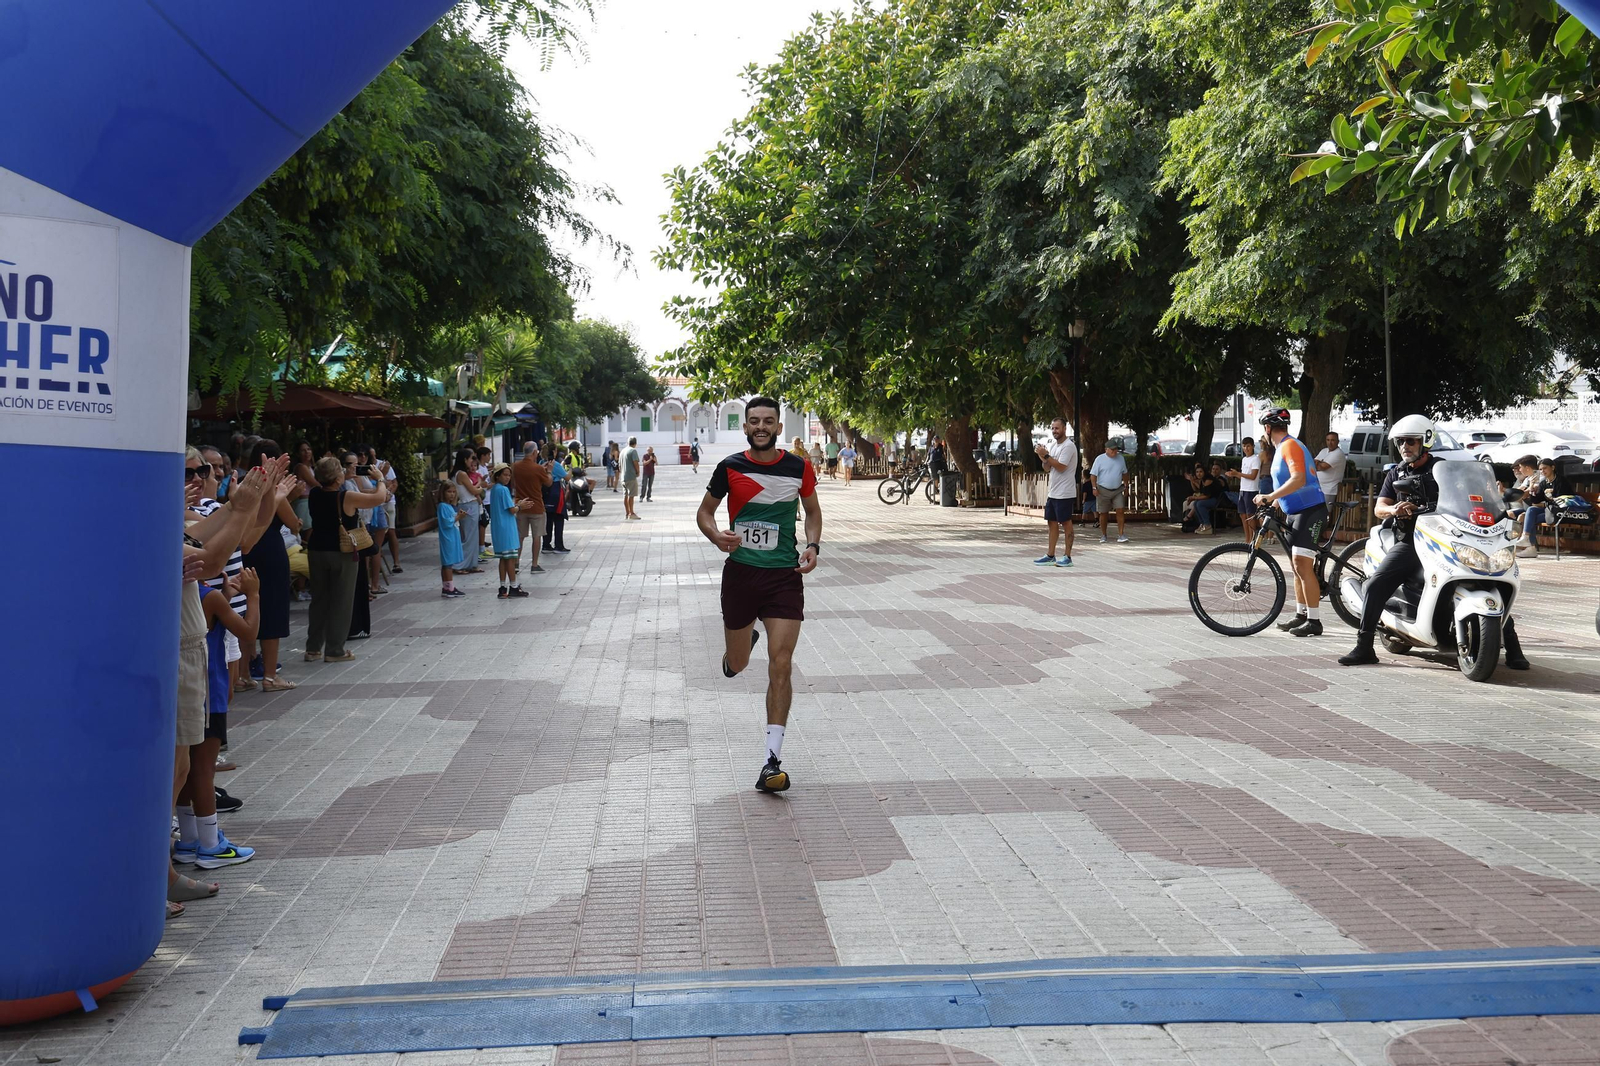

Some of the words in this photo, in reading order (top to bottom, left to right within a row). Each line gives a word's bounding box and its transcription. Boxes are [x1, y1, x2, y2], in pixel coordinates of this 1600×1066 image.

[0, 395, 34, 409] CIÓN
[37, 398, 54, 410] DE
[58, 400, 113, 414] EVENTOS
[1455, 519, 1482, 534] POLICIA
[743, 528, 769, 545] 151
